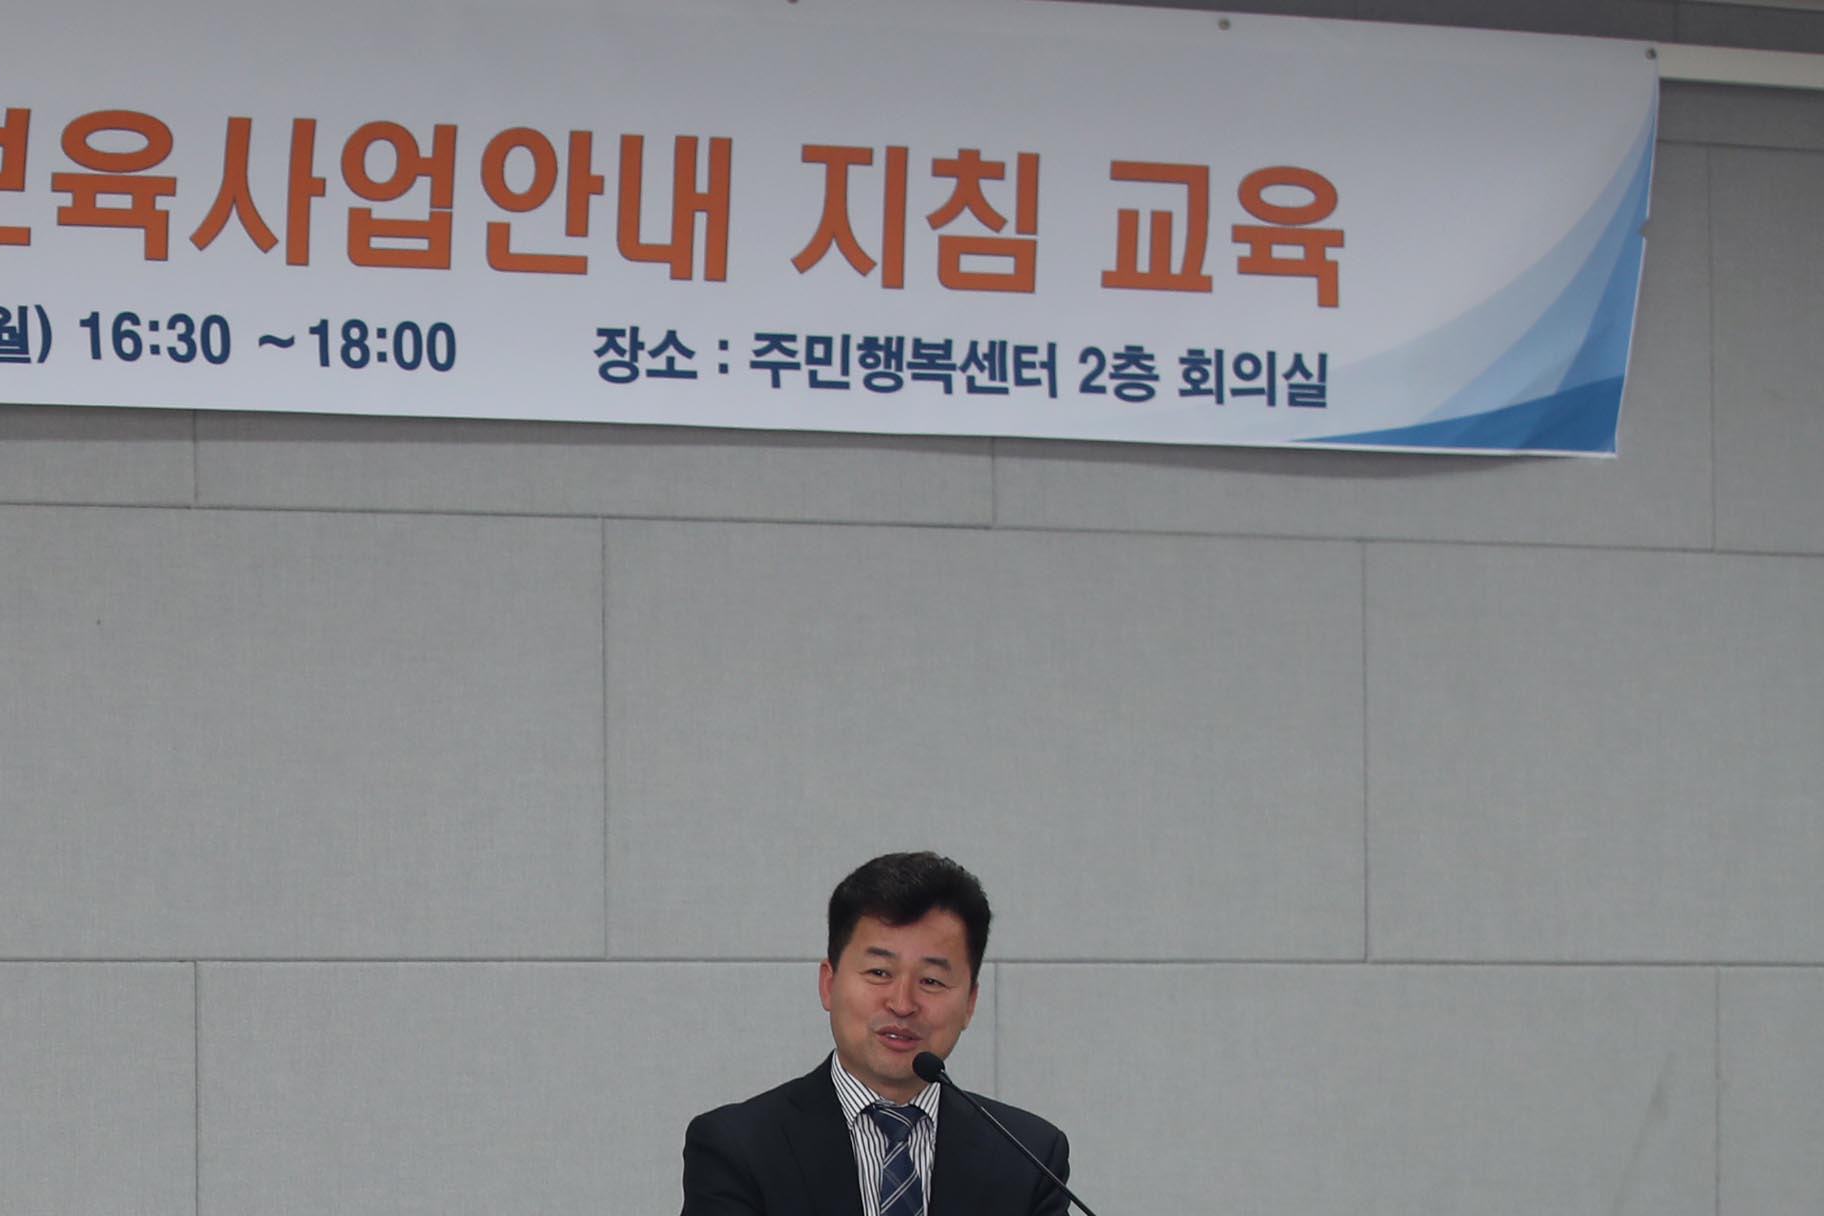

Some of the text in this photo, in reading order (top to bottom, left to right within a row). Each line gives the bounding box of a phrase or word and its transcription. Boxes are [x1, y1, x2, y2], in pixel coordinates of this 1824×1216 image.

[792, 144, 1040, 294] 지침
[1102, 160, 1345, 309] 교육
[79, 311, 231, 365] 16:30
[593, 325, 698, 384] 장소
[749, 332, 1059, 399] 주민행복센터
[1079, 345, 1160, 403] 2층
[1178, 348, 1328, 409] 회의실
